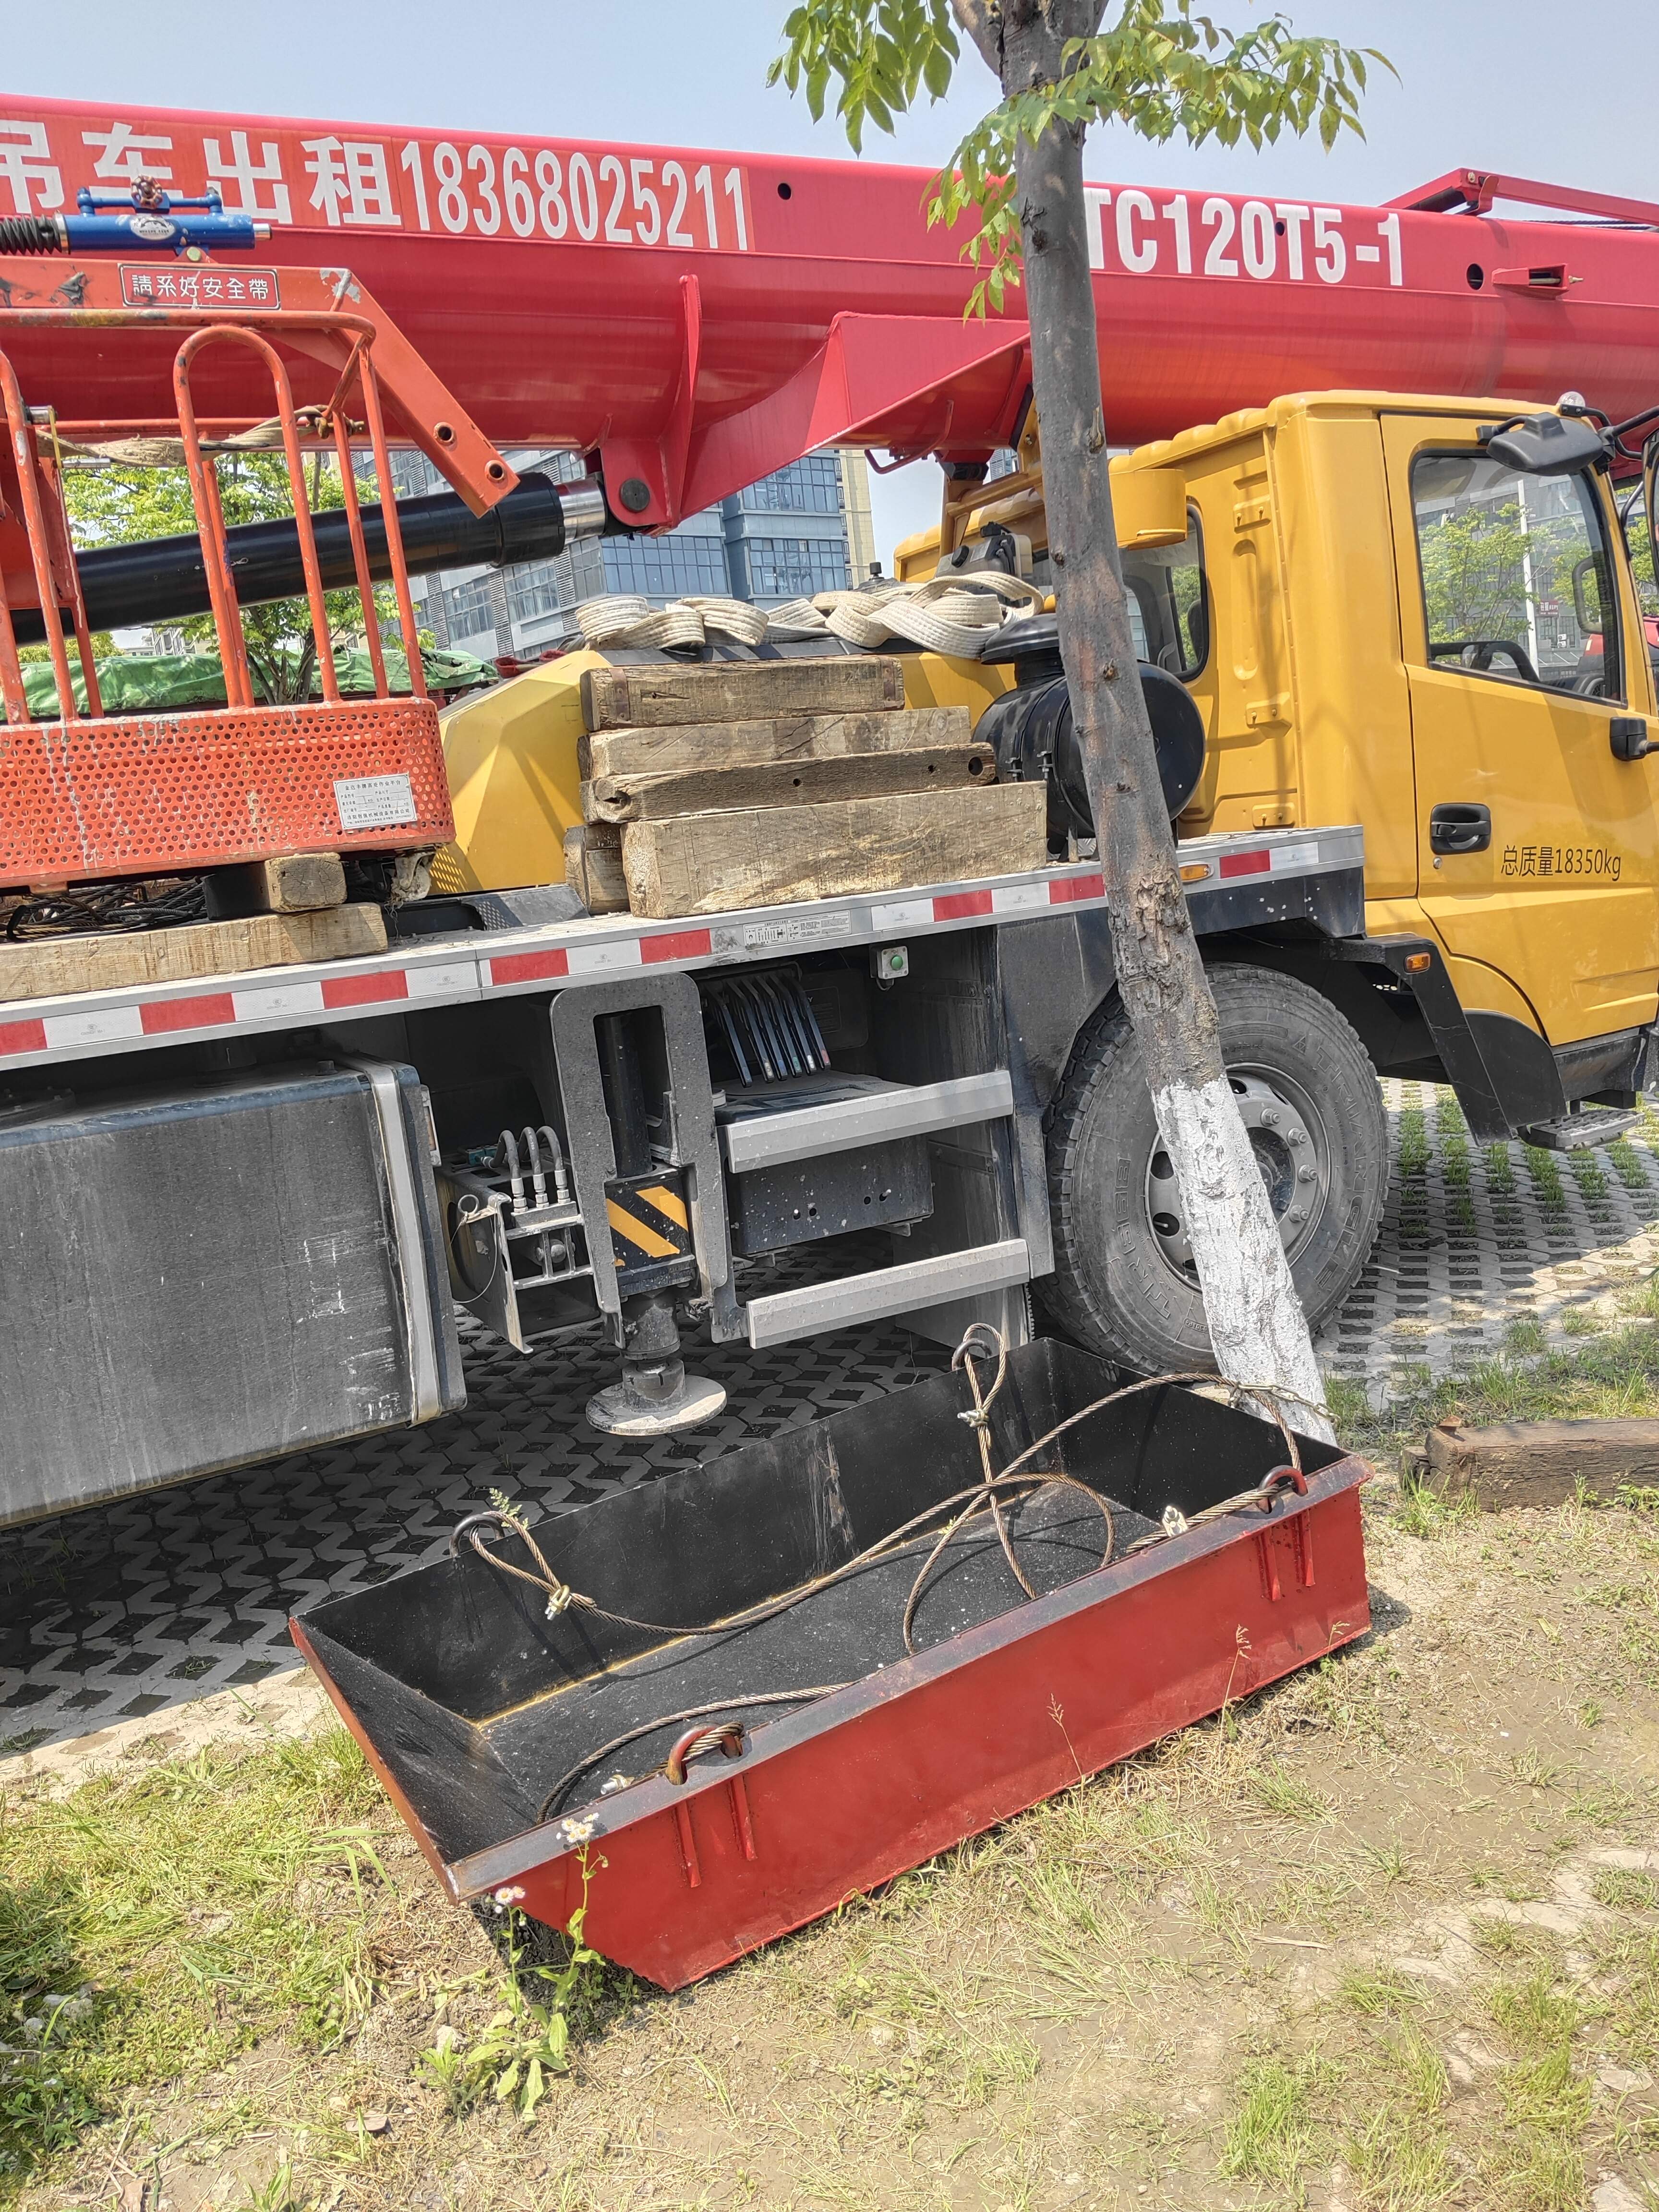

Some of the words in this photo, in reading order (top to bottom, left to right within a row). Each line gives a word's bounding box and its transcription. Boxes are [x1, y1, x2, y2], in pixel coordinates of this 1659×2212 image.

[132, 274, 269, 301] 請系好安全帶
[1501, 844, 1621, 881] 总质量18350kg
